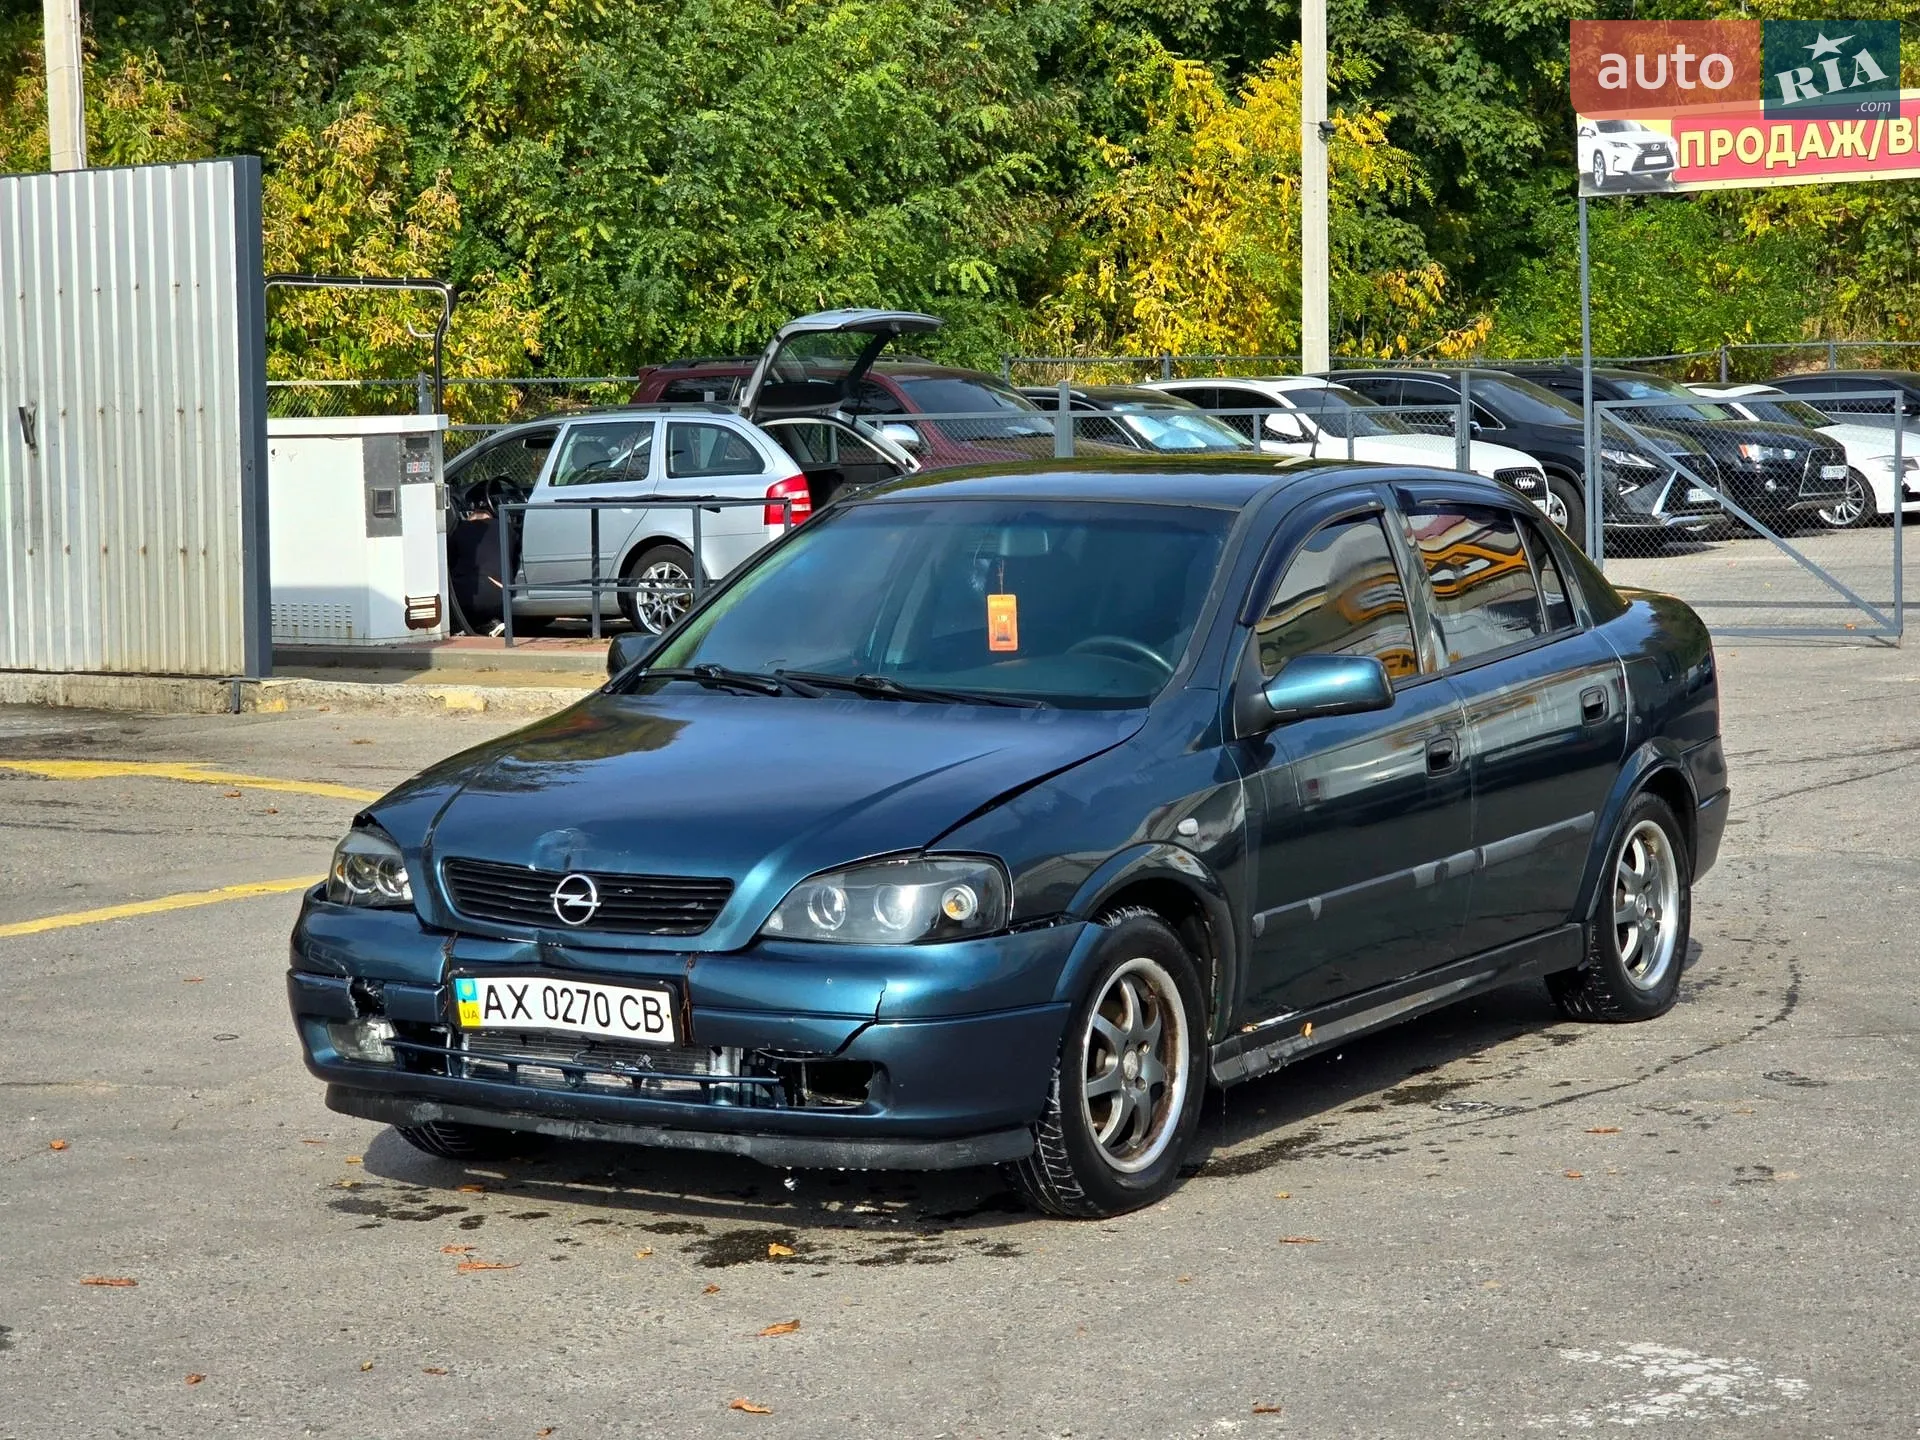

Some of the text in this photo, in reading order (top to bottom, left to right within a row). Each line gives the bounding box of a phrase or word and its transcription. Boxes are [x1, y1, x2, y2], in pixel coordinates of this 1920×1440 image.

[1680, 115, 1920, 169] ПРОДАЖ/В
[463, 1009, 479, 1020] UA
[484, 984, 664, 1033] AX 0270 CB
